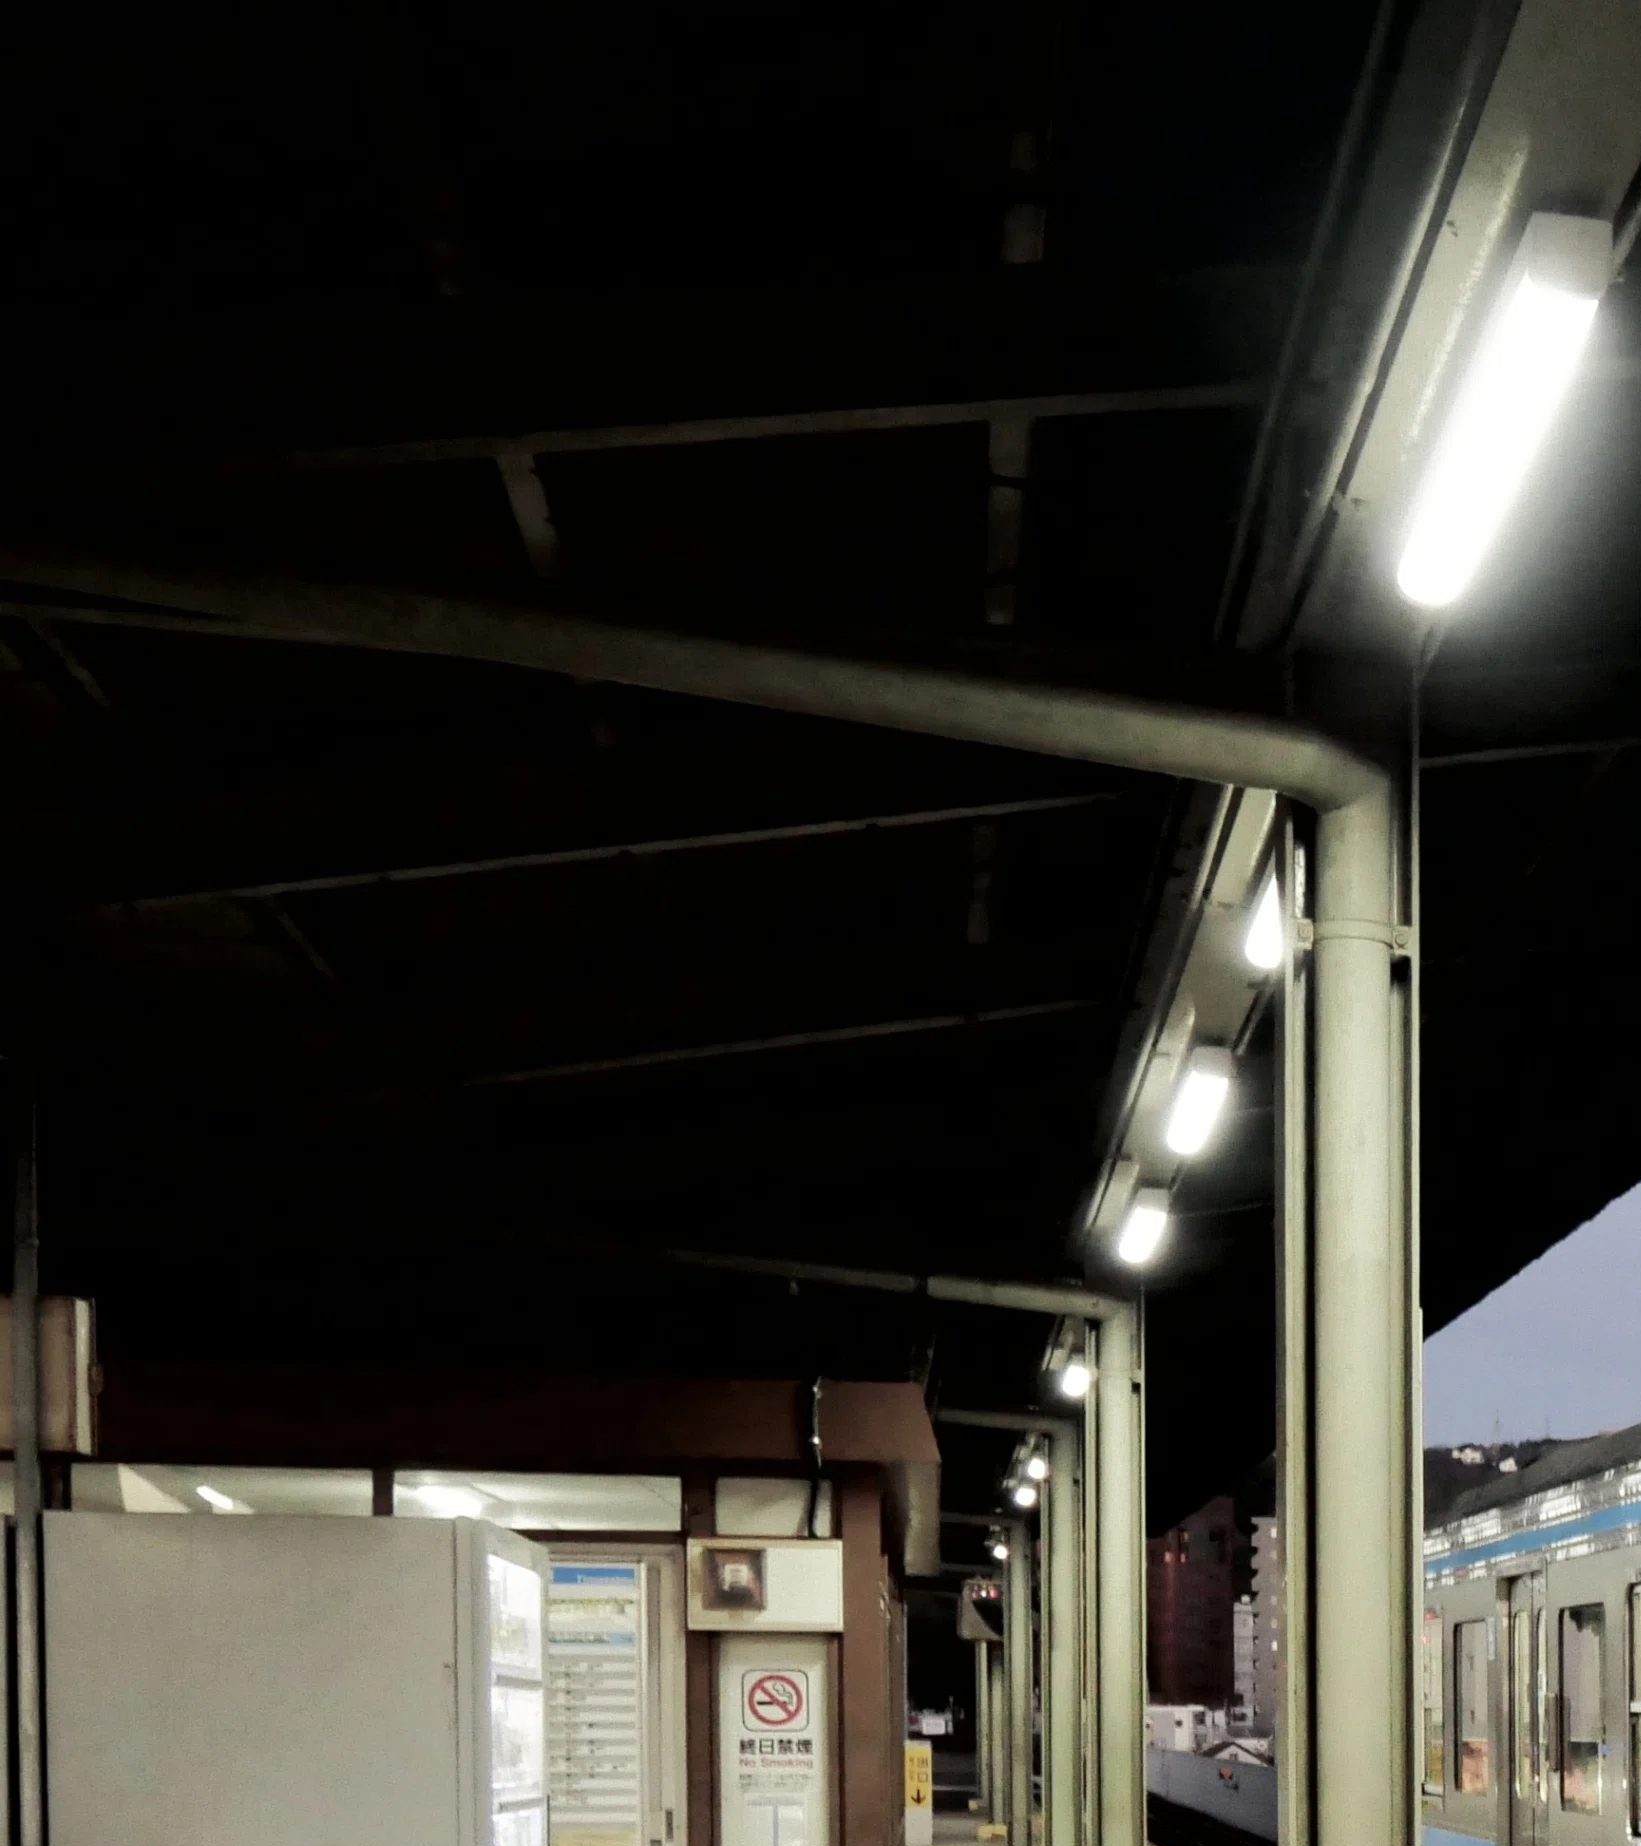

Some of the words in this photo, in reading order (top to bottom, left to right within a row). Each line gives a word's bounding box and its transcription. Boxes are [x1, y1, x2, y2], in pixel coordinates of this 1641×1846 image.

[740, 1739, 813, 1755] 終日禁煙
[739, 1757, 757, 1768] No
[761, 1757, 814, 1769] Smoking
